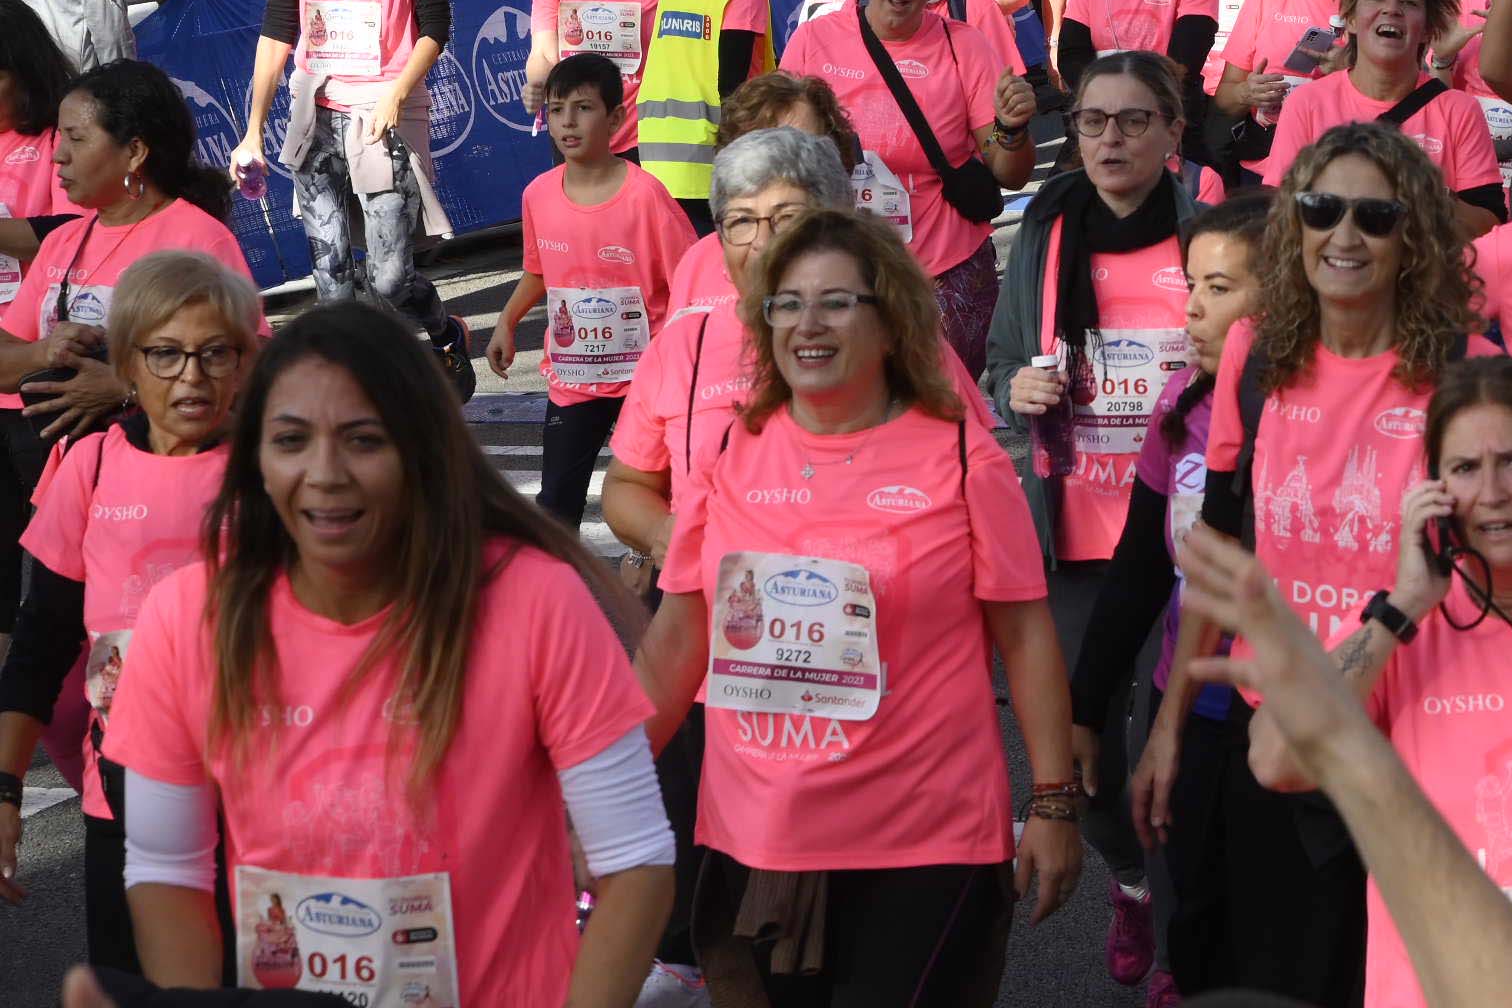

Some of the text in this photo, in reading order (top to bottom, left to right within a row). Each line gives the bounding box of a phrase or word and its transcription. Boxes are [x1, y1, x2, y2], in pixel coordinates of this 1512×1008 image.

[586, 30, 613, 42] 016
[822, 63, 865, 80] OYSHO
[537, 238, 569, 253] OYSHO
[575, 303, 614, 315] ASTURIANA
[578, 326, 613, 340] 016
[584, 344, 606, 353] 7217
[1159, 344, 1185, 353] SUMA
[557, 368, 585, 377] OYSHO
[1102, 378, 1148, 396] 016
[1106, 401, 1143, 412] 20798
[1110, 417, 1122, 425] DE
[1123, 417, 1134, 425] LA
[747, 488, 813, 505] OYSHO
[871, 494, 927, 510] ASTURIANA
[770, 581, 833, 601] ASTURIANA
[769, 618, 825, 643] 016
[776, 647, 812, 663] 9272
[729, 663, 773, 677] CARRERA
[774, 667, 788, 678] DE
[790, 669, 803, 679] LA
[804, 671, 839, 683] MUJER
[723, 684, 772, 700] OYSHO
[815, 692, 867, 708] Santander
[1424, 693, 1504, 715] OYSHO
[736, 712, 850, 749] SUMA
[388, 902, 433, 916] SUMA
[301, 905, 374, 930] ASTURIANA
[308, 952, 376, 982] 016
